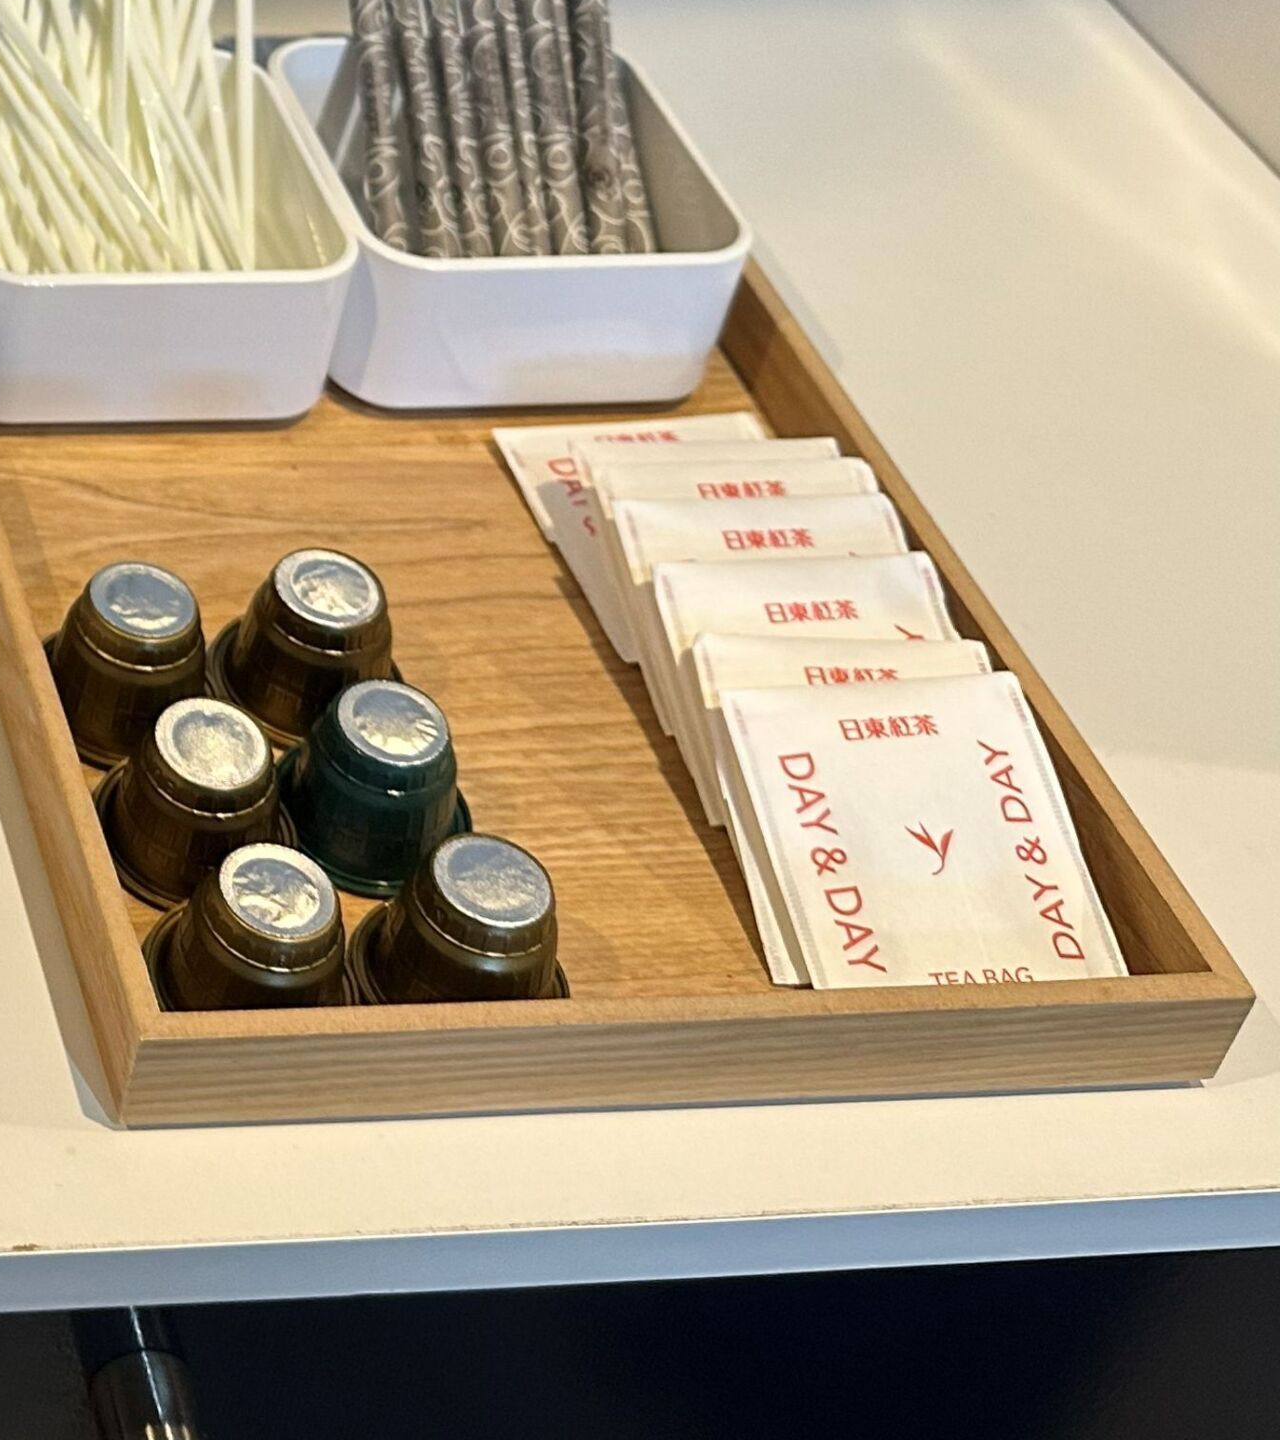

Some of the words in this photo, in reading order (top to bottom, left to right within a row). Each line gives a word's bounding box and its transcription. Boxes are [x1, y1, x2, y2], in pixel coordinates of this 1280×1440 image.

[722, 528, 814, 551] 日東紅茶
[764, 599, 859, 623] 日東紅茶
[838, 714, 939, 741] 日東紅茶
[778, 752, 838, 836] DAY
[976, 740, 1033, 823] DAY
[810, 847, 848, 876] &
[1015, 836, 1048, 865] &
[824, 886, 887, 973] DAY
[1024, 874, 1086, 960] DAY
[928, 970, 977, 986] TEA
[982, 967, 1034, 984] BAG
